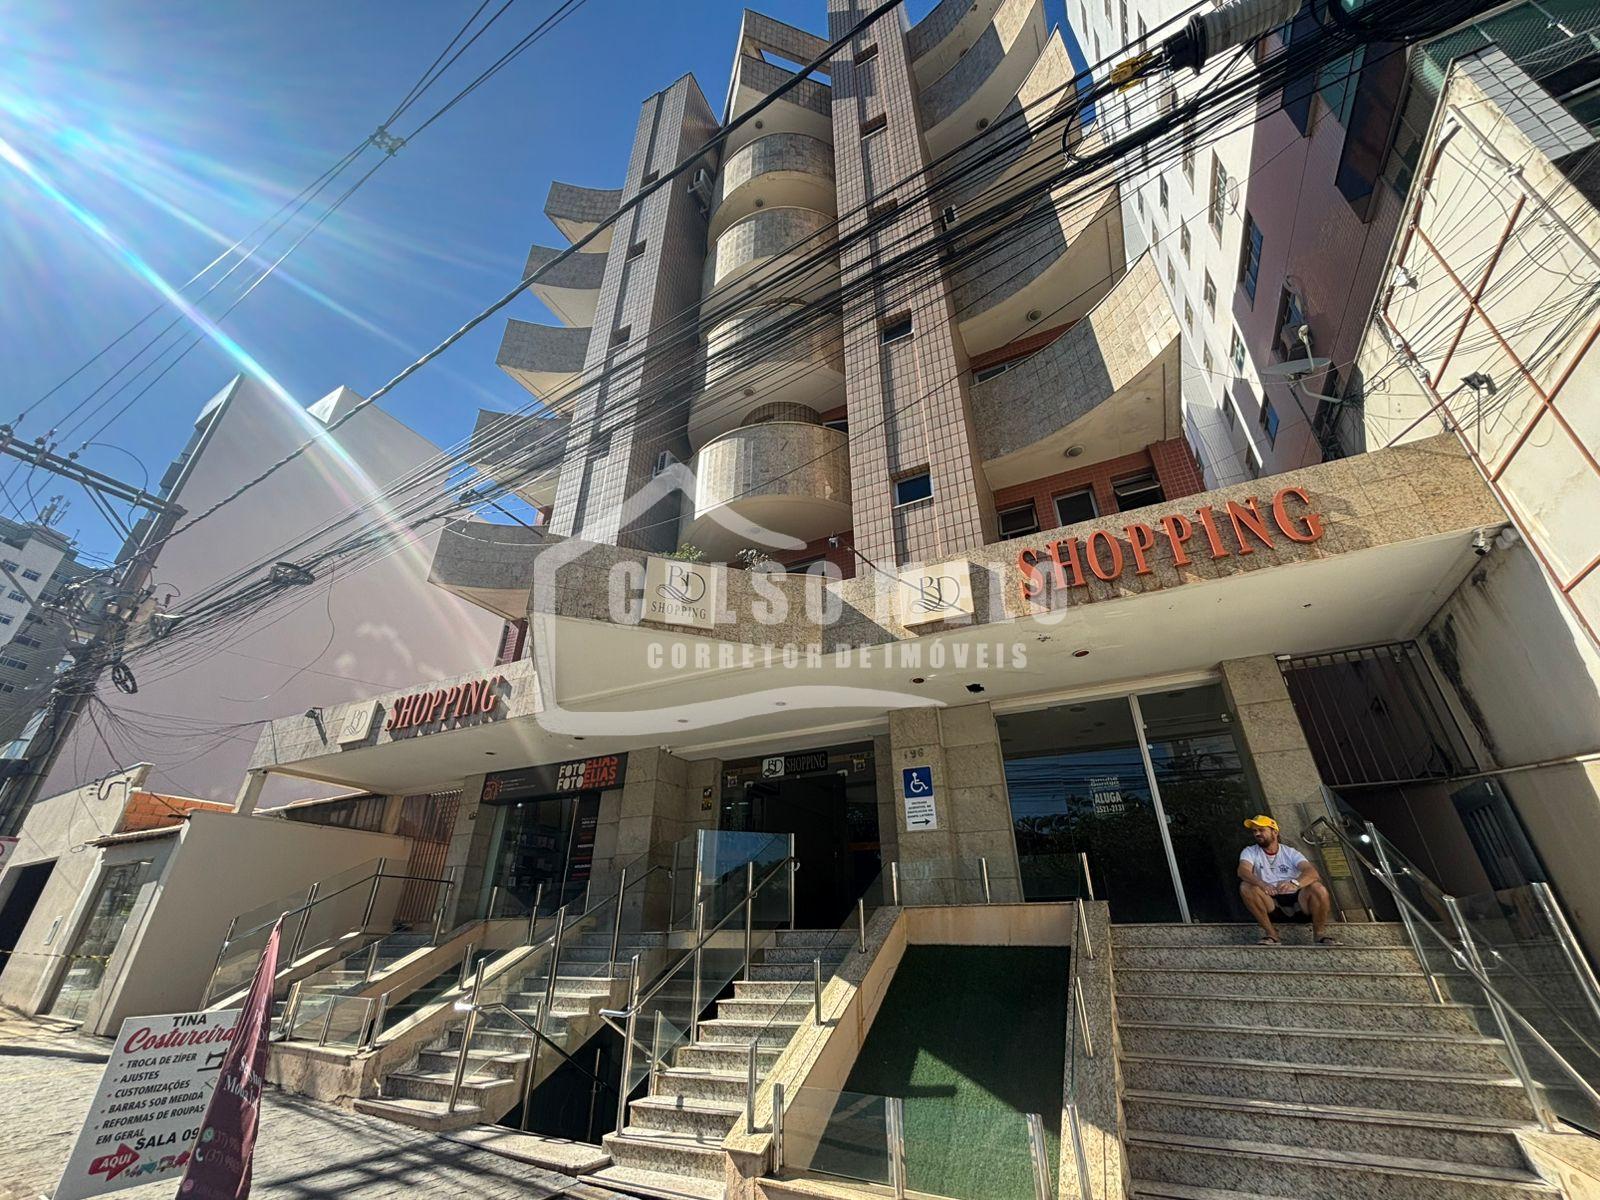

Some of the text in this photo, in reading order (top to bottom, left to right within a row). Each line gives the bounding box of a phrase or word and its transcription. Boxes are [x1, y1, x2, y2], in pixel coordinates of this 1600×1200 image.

[1019, 486, 1324, 599] SHOPPING
[651, 601, 707, 620] SHOPPING
[386, 675, 503, 731] SHOPPING
[558, 762, 586, 778] FOTO
[785, 754, 826, 773] SHOPPING
[556, 775, 584, 791] FOTO
[584, 766, 617, 782] ELIAS
[1094, 791, 1123, 804] ALUGA
[172, 1014, 207, 1027] TINA
[123, 1024, 236, 1054] Costureira
[126, 1052, 198, 1069] TROCA DE ZÍPER
[119, 1070, 160, 1084] AJUSTES
[108, 1091, 204, 1114] BARRAS SOB MEDIDA
[102, 1103, 206, 1130] REFORMAS DE ROUPAS
[95, 1127, 145, 1145] EM GERAL
[134, 1128, 199, 1151] SALA 09
[99, 1152, 132, 1169] AQUI
